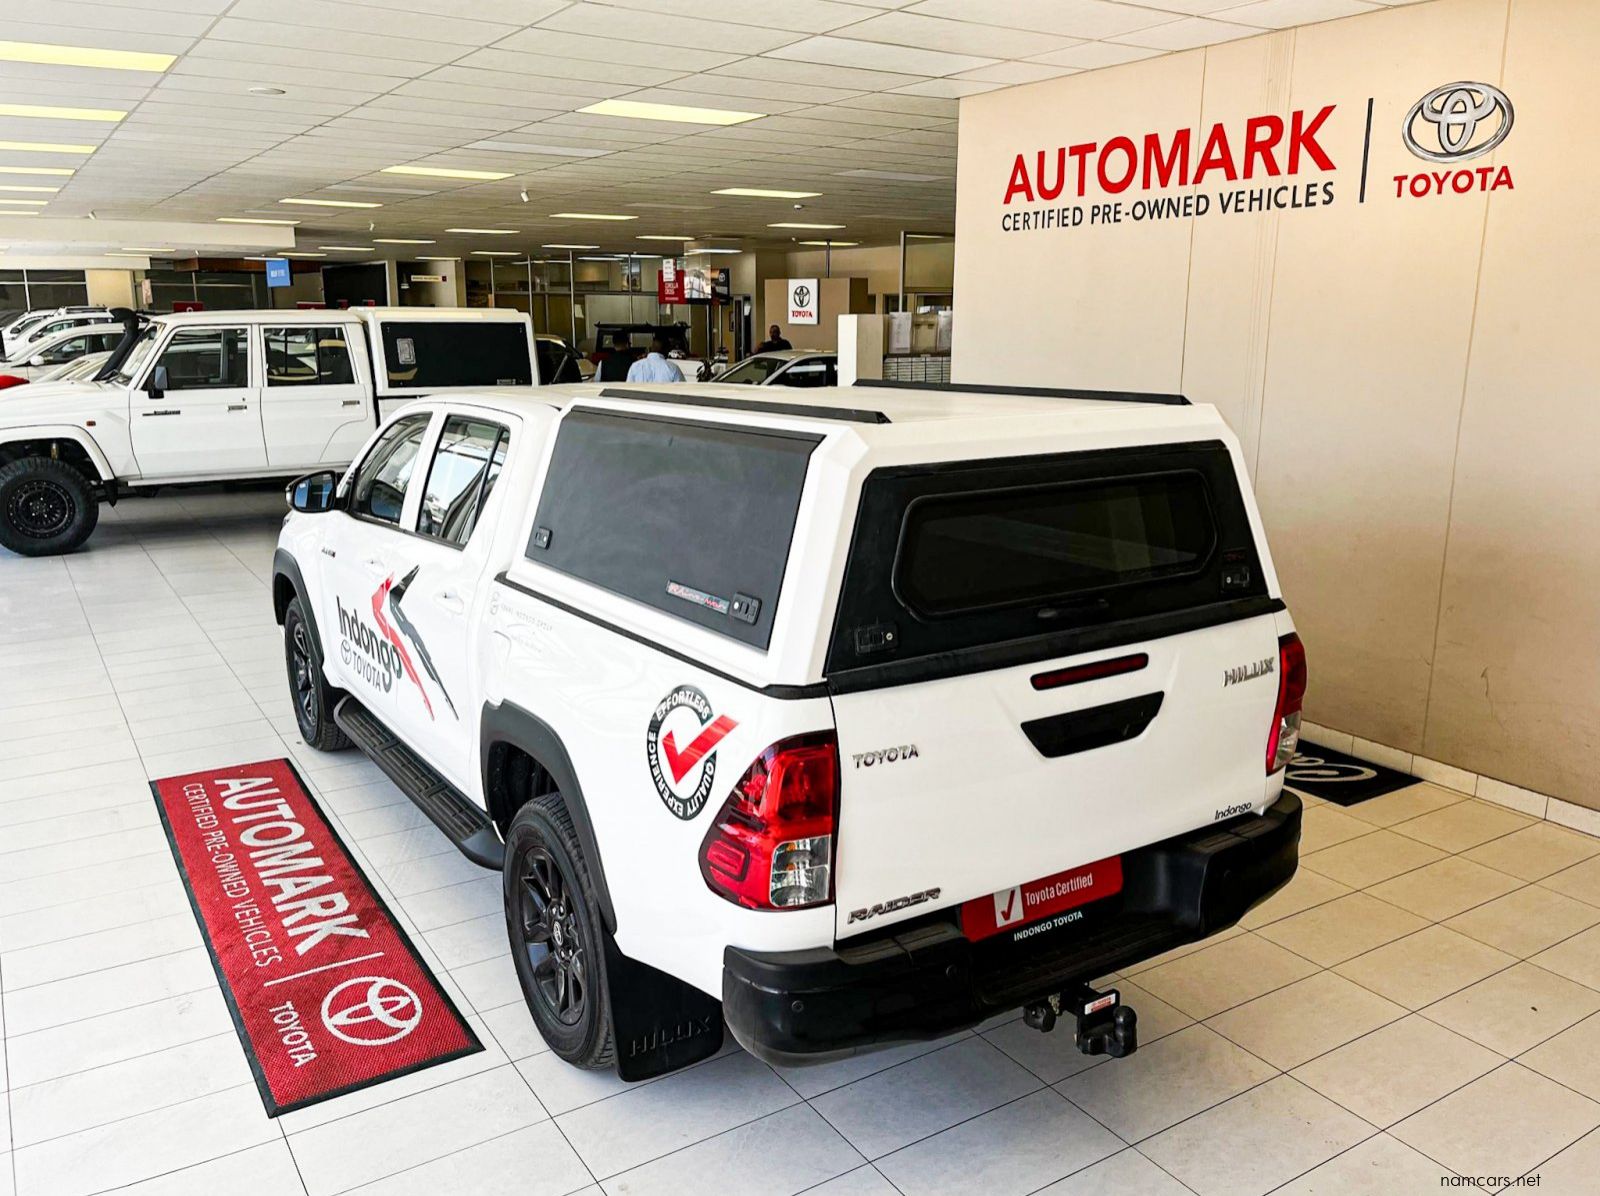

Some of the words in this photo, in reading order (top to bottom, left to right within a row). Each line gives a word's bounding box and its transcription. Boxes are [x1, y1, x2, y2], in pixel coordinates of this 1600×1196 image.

[1003, 104, 1337, 204] AUTOMARK
[1393, 165, 1515, 199] TOYOTA
[1002, 206, 1084, 232] CERTIFIED
[1090, 194, 1211, 225] PRE-OWNED
[1219, 181, 1335, 213] VEHICLES
[791, 310, 813, 318] TOYOTA
[336, 595, 403, 693] Indongo
[352, 651, 382, 692] TOYOTA
[1222, 656, 1274, 687] HILUX
[656, 690, 711, 720] EFFORTLESS
[648, 731, 685, 817] EXPERIENCE
[853, 744, 919, 768] TOYOTA
[686, 761, 715, 817] QUALITY
[1214, 801, 1252, 820] Indongo
[182, 783, 219, 834] CERTIFIED
[204, 829, 250, 899] PRE-OWNED
[231, 898, 283, 968] VEHICLES
[214, 776, 370, 955] AUTOMARK
[847, 887, 941, 925] RAIDER
[1024, 885, 1056, 908] Toyota
[1055, 872, 1094, 900] Certified
[1013, 920, 1053, 941] INDONGO
[1053, 911, 1084, 932] TOYOTA
[269, 1000, 318, 1068] TOYOTA
[629, 1015, 711, 1057] HILUX
